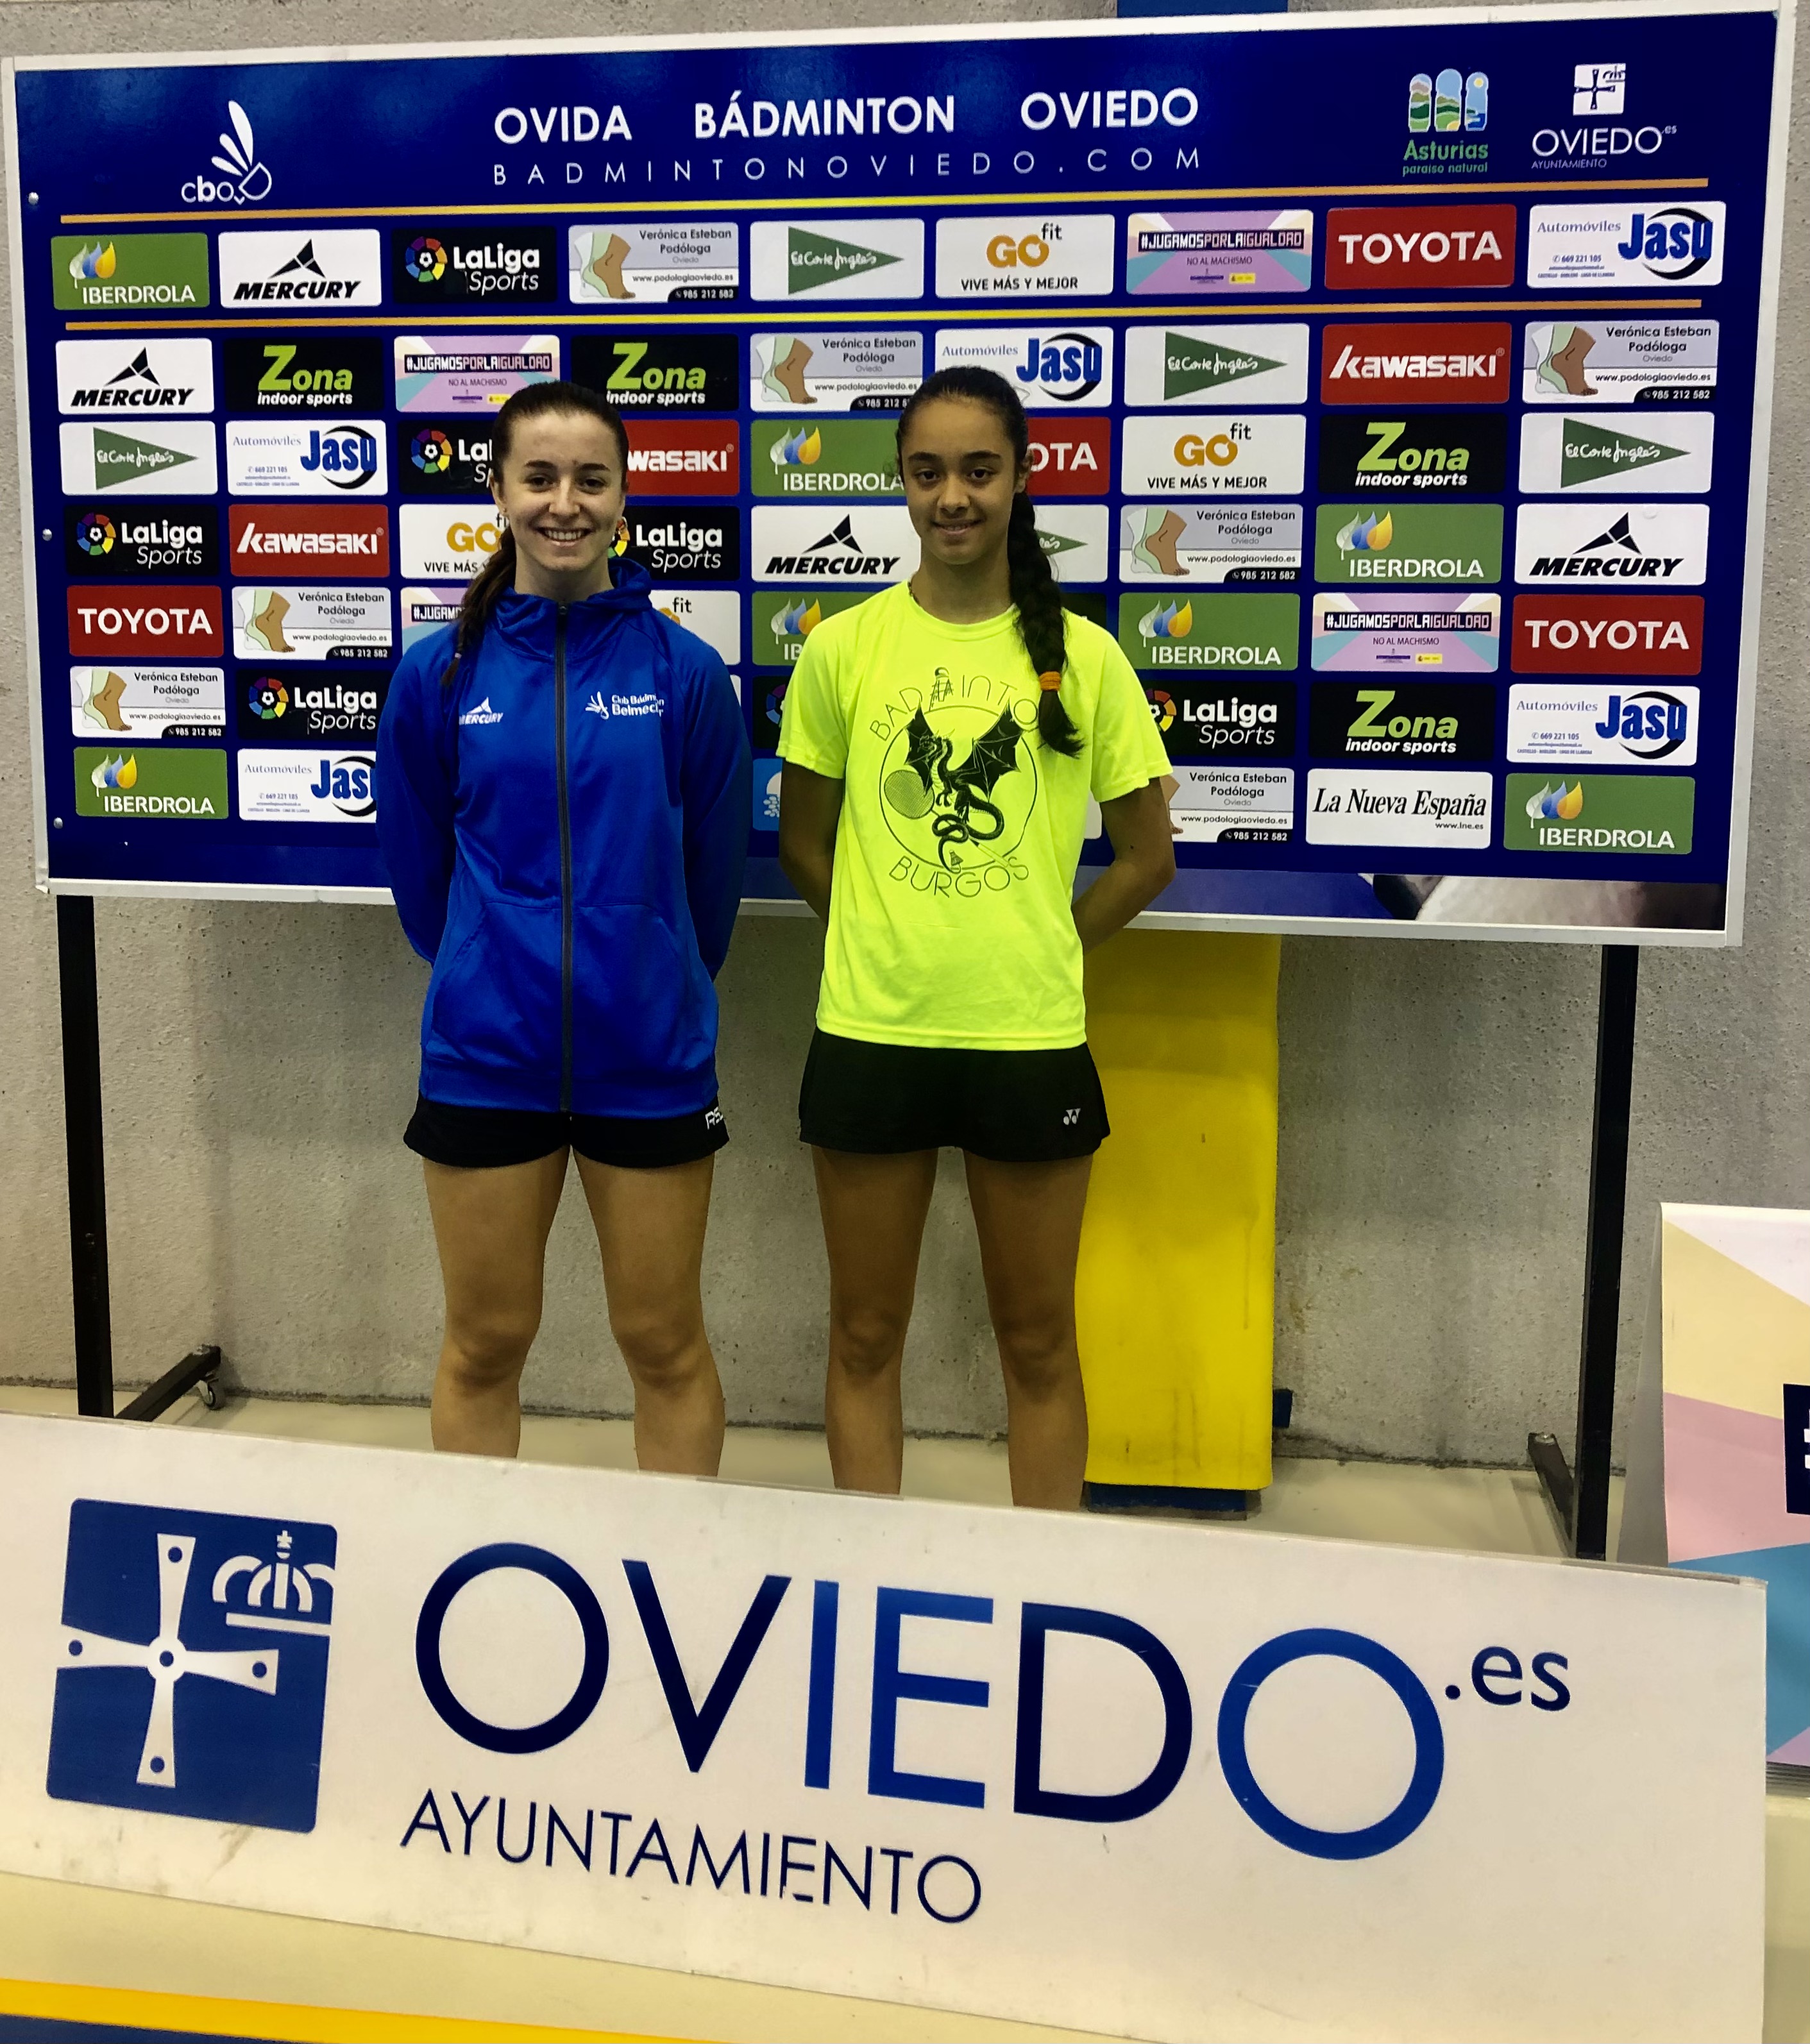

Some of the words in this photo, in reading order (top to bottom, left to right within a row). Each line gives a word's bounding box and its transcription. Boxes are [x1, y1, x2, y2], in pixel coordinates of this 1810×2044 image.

[495, 105, 632, 144] OVIDA
[695, 90, 954, 139] BÁDMINTON
[1020, 87, 1198, 130] OVIEDO
[1403, 139, 1488, 160] Asturias
[1448, 162, 1488, 173] natural
[1531, 158, 1607, 169] AYUNTAMIENTO
[639, 228, 687, 240] Verónica
[690, 228, 732, 239] Esteban
[1537, 221, 1621, 233] Automóviles
[1618, 213, 1713, 260] Jasu
[660, 242, 711, 255] Podóloga
[986, 235, 1049, 268] GO
[1041, 223, 1062, 240] fit
[1339, 231, 1503, 264] TOYOTA
[453, 243, 540, 273] LaLiga
[1187, 257, 1198, 266] NO
[1200, 257, 1208, 266] AL
[1210, 256, 1252, 265] MACHISMO
[233, 281, 362, 300] MERCURY
[468, 271, 539, 296] Sports
[961, 279, 988, 291] VIVE
[993, 275, 1019, 291] MÁS
[1024, 278, 1031, 289] Y
[1036, 277, 1078, 289] MEJOR
[82, 285, 196, 304] IBERDROLA
[1606, 326, 1660, 337] Verónica
[1664, 326, 1711, 337] Esteban
[822, 337, 870, 349] Verónica
[874, 338, 916, 348] Esteban
[1629, 341, 1687, 353] Podóloga
[607, 342, 706, 390] Zona
[843, 351, 895, 364] Podóloga
[942, 344, 1019, 357] Automóviles
[1016, 338, 1103, 383] Jasu
[1168, 356, 1181, 371] El
[1181, 356, 1212, 371] Corte
[1213, 352, 1258, 375] Inglés
[258, 345, 353, 391] Zona
[1596, 373, 1711, 383] www.podologiaoviedo.es
[71, 388, 195, 407] MERCURY
[257, 392, 303, 405] indoor
[306, 392, 353, 407] sports
[606, 391, 654, 404] indoor
[656, 391, 706, 406] sports
[1652, 390, 1669, 399] 985
[1673, 391, 1690, 399] 212
[1693, 390, 1710, 399] 582
[233, 435, 301, 446] Automóviles
[300, 430, 377, 471] Jasu
[1174, 434, 1238, 467] GO
[1230, 423, 1251, 440] fit
[1357, 422, 1470, 471] Zona
[1565, 443, 1578, 458] El
[1580, 443, 1612, 459] Corte
[1612, 440, 1661, 463] Inglés
[628, 450, 727, 472] wasaki
[1028, 443, 1097, 471] OTA
[783, 473, 904, 491] IBERDROLA
[1147, 477, 1175, 489] VIVE
[1181, 474, 1207, 488] MÁS
[1212, 477, 1219, 488] Y
[1224, 477, 1267, 488] MEJOR
[1355, 472, 1410, 487] indoor
[1412, 473, 1467, 487] sports
[1197, 510, 1247, 520] Verónica
[1251, 511, 1295, 520] Esteban
[121, 519, 203, 549] LaLiga
[446, 522, 501, 553] GO
[636, 522, 723, 552] LaLiga
[1218, 523, 1273, 537] Podóloga
[136, 546, 202, 568] Sports
[424, 562, 449, 572] VIVE
[454, 560, 478, 572] MÁS
[651, 549, 721, 572] Sports
[765, 556, 901, 575] MERCURY
[1187, 555, 1296, 564] www.podologiaoviedo.es
[1529, 557, 1684, 576] MERCURY
[1241, 571, 1256, 580] 985
[1260, 571, 1276, 580] 212
[1280, 571, 1295, 580] 582
[1350, 559, 1484, 577] IBERDROLA
[298, 592, 343, 602] Verónica
[346, 593, 384, 602] Esteban
[673, 598, 692, 613] fit
[318, 605, 365, 616] Podóloga
[78, 608, 213, 635] TOYOTA
[1525, 620, 1689, 650] TOYOTA
[1152, 646, 1281, 665] IBERDROLA
[134, 671, 178, 681] Verónica
[181, 673, 218, 682] Esteban
[154, 684, 199, 697] Podóloga
[294, 685, 377, 711] LaLiga
[1183, 697, 1278, 728] LaLiga
[1347, 690, 1459, 738] Zona
[1516, 700, 1598, 711] Automóviles
[1595, 695, 1687, 741] Jasu
[309, 711, 376, 734] Sports
[1199, 725, 1275, 749] Sports
[1346, 738, 1403, 752] indoor
[1403, 741, 1457, 755] sports
[244, 764, 312, 774] Automóviles
[310, 759, 376, 799] Jas
[1189, 771, 1239, 782] Verónica
[1244, 773, 1287, 783] Esteban
[1211, 786, 1264, 798] Podóloga
[104, 797, 215, 815] IBERDROLA
[1312, 788, 1342, 813] La
[1345, 789, 1407, 814] Nueva
[1412, 790, 1487, 820] España
[1181, 816, 1287, 824] www.podologiaoviedo.es
[1435, 822, 1484, 830] www.lne.es
[1234, 832, 1249, 840] 985
[1253, 832, 1268, 840] 212
[1272, 832, 1287, 841] 582
[1540, 827, 1675, 849] IBERDROLA
[889, 855, 1029, 898] BURGOS
[400, 1788, 981, 1924] AYUNTAMIENTO
